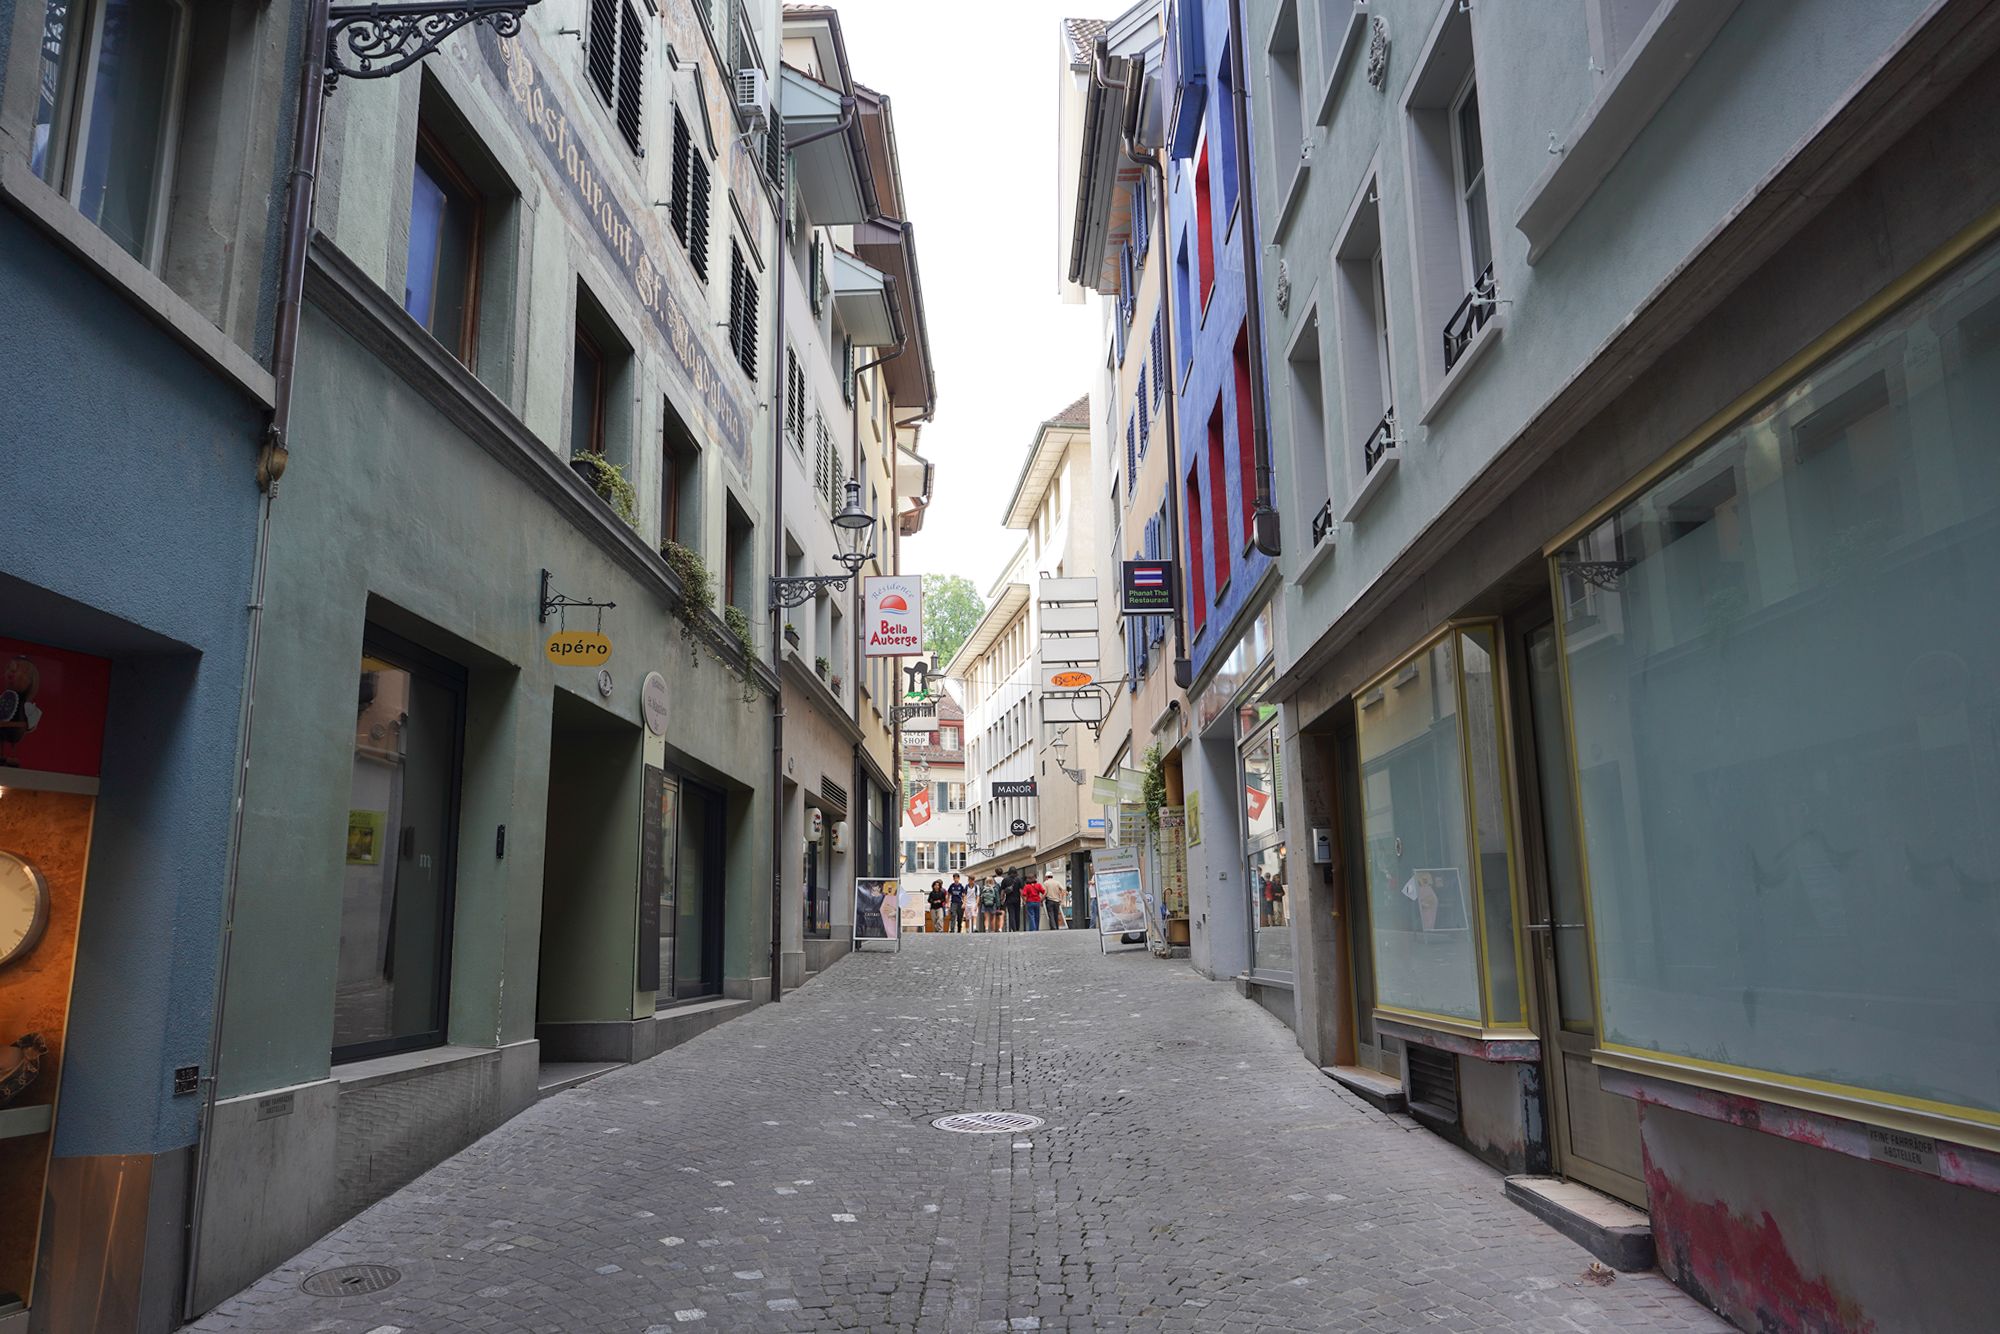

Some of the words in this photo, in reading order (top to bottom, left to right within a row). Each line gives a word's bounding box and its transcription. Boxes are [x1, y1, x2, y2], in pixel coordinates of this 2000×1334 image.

[498, 35, 632, 267] Restaurant
[880, 619, 908, 635] Bella
[870, 631, 918, 646] Auberge
[550, 639, 608, 656] apéro
[903, 737, 926, 745] SHOP
[997, 785, 1032, 794] MANOR
